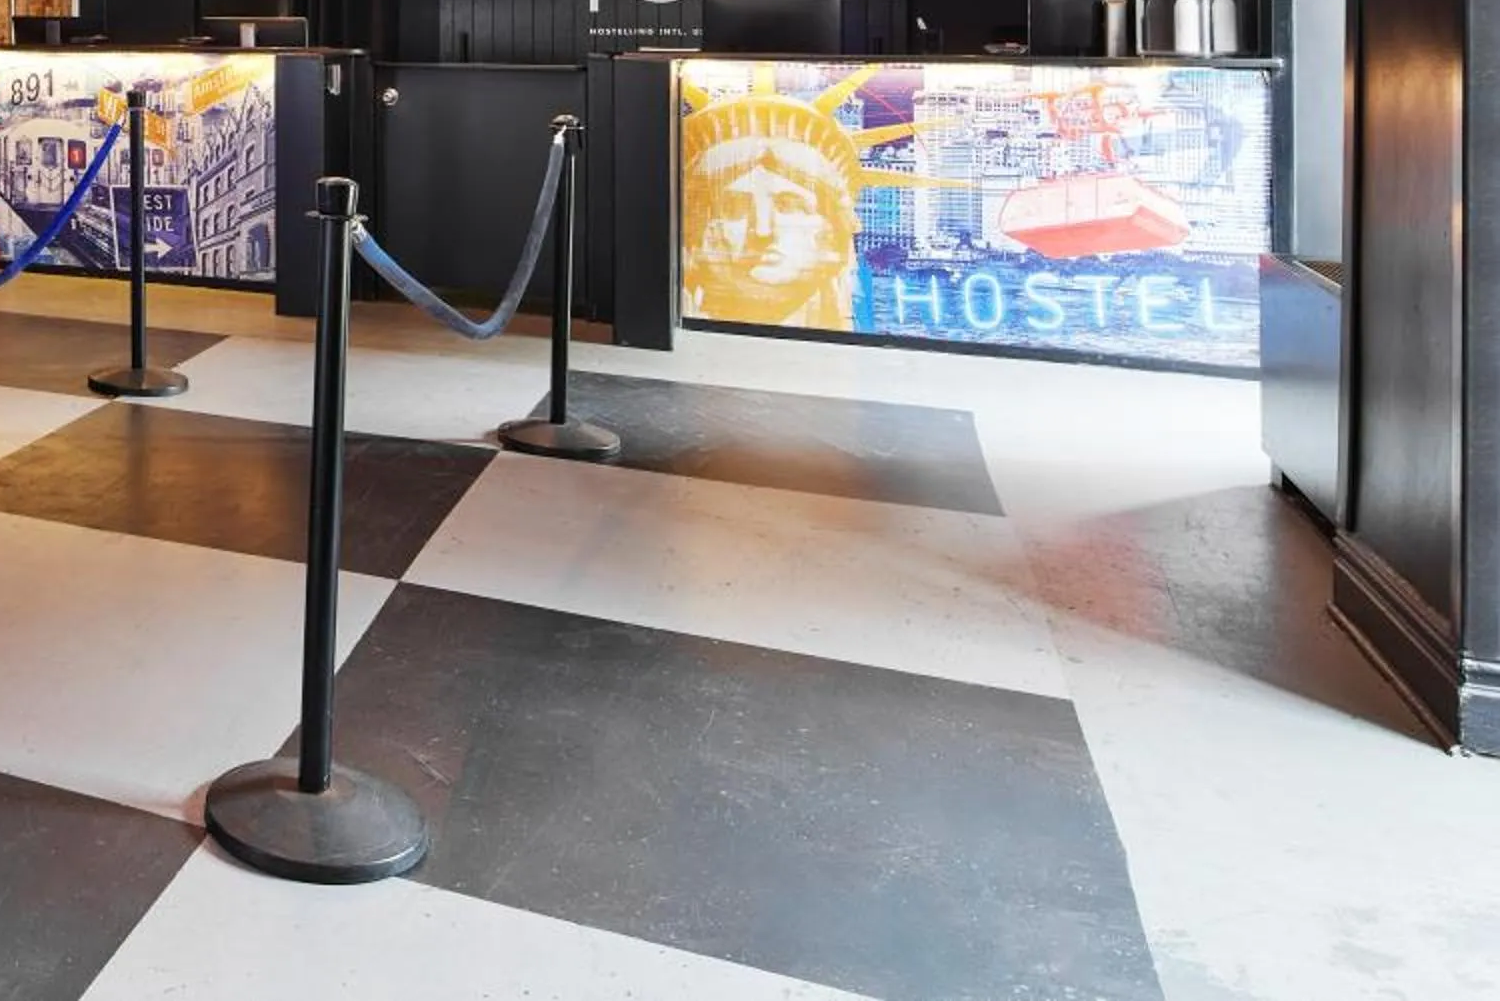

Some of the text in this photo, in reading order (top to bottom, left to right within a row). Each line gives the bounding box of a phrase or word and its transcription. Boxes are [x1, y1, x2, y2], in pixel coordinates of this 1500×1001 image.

[11, 69, 53, 105] 891
[143, 194, 172, 210] EST
[146, 216, 174, 232] IDE
[894, 271, 1242, 332] HOSTEL
